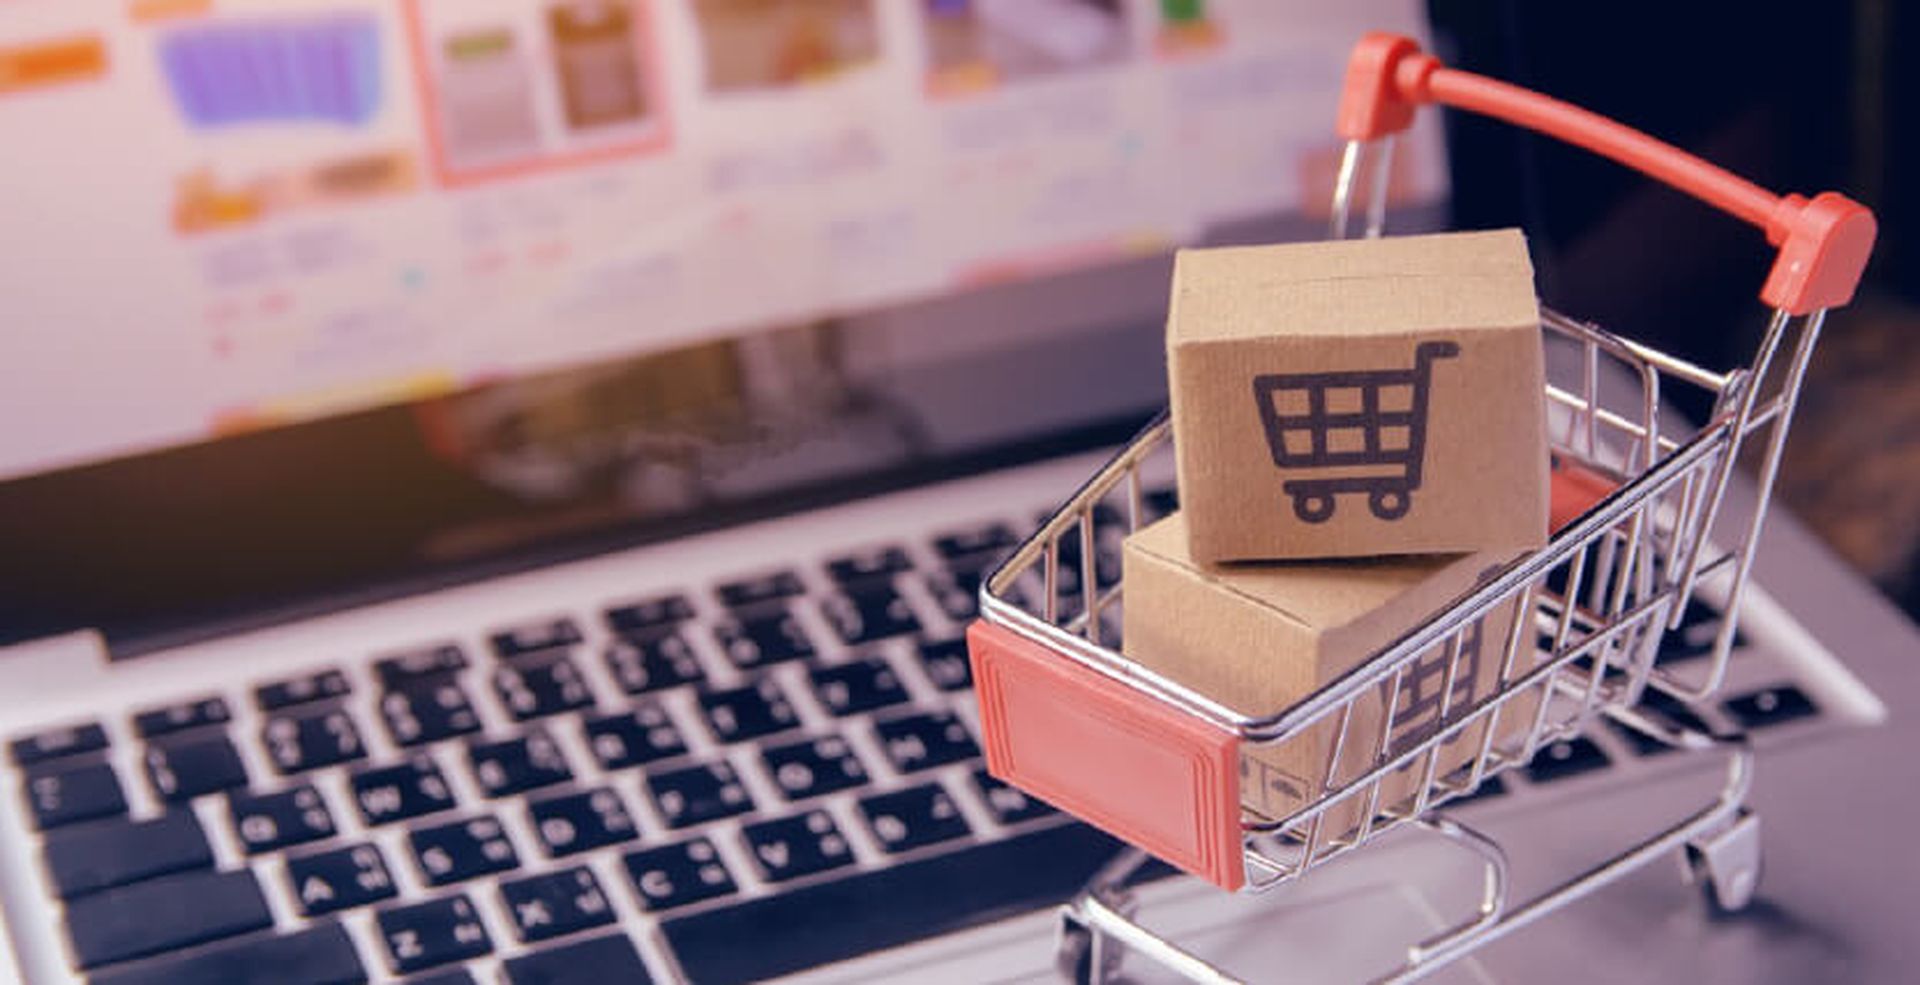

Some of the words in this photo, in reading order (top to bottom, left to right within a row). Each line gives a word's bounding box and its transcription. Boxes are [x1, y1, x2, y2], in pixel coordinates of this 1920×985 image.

[302, 877, 333, 905] A
[639, 870, 672, 898] C
[517, 900, 551, 928] X
[391, 930, 423, 958] Z
